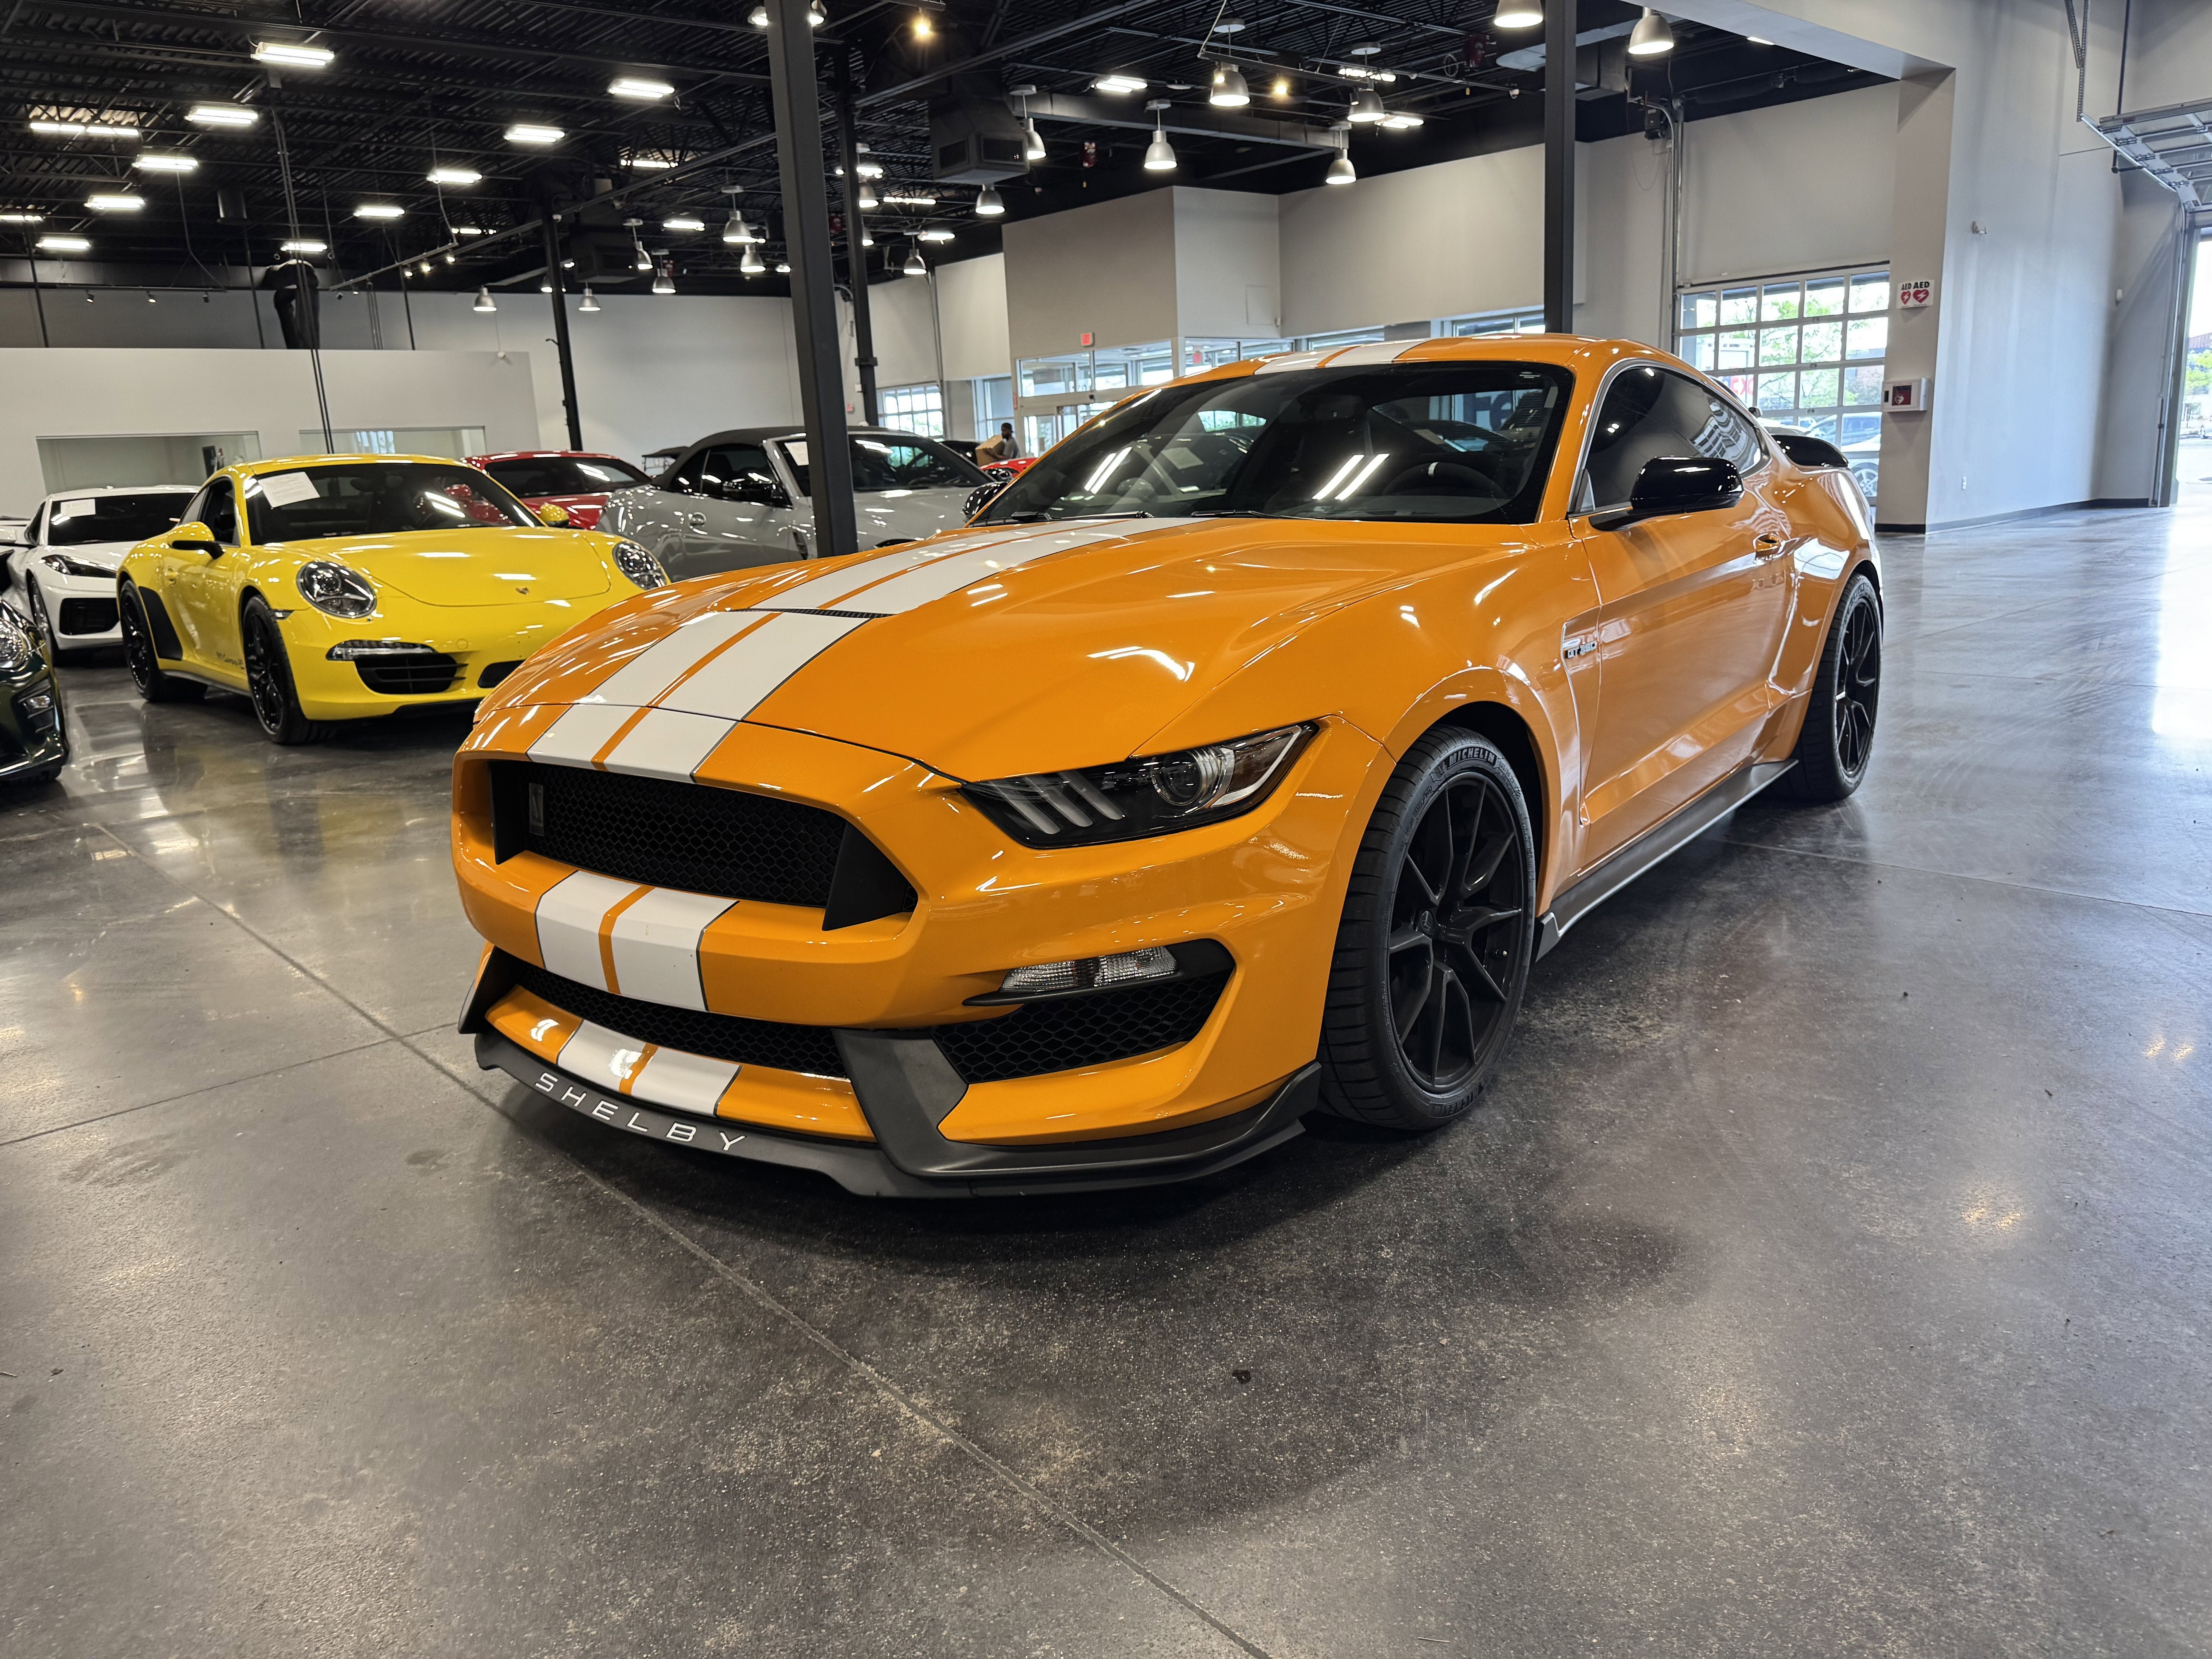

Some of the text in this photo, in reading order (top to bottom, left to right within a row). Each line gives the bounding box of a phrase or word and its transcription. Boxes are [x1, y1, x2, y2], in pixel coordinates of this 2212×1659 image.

[1901, 283, 1911, 291] AED
[1913, 281, 1930, 289] AED
[1449, 747, 1495, 766] MICHELIN
[535, 1072, 745, 1151] SHELBY
